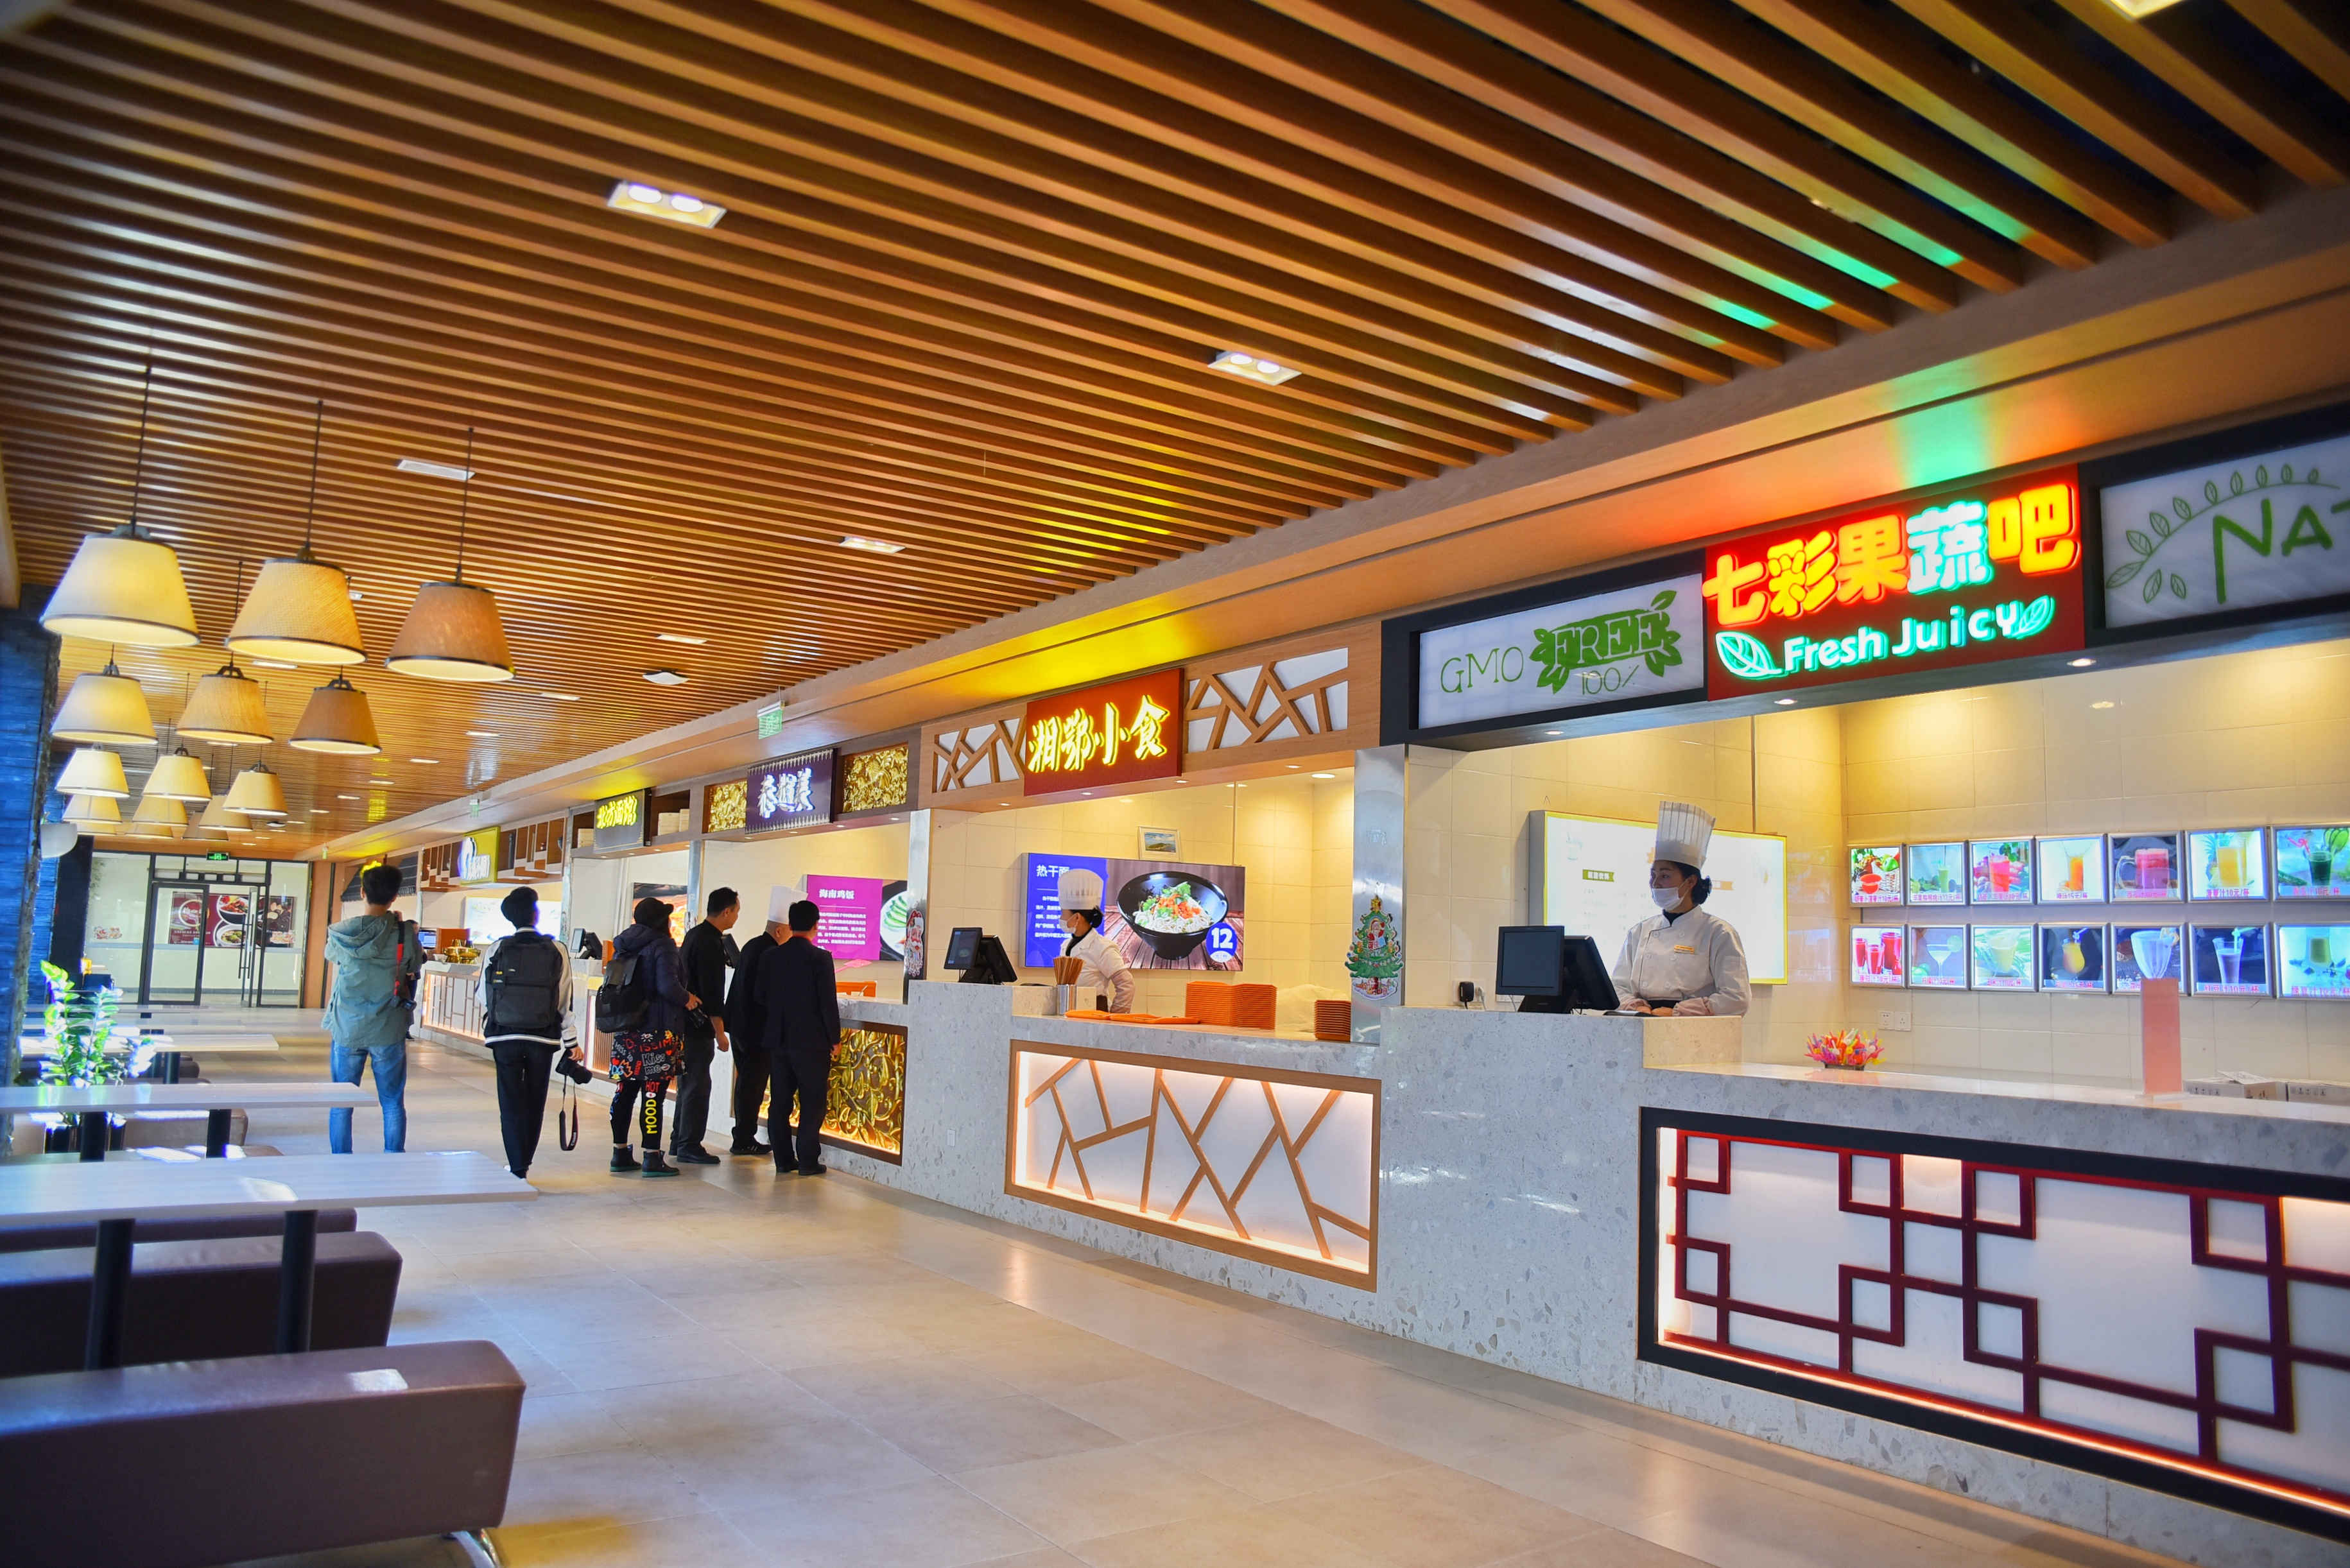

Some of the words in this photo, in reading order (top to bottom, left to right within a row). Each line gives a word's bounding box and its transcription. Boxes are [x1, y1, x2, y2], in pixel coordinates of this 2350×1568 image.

[1703, 484, 2078, 626] 七彩果蔬吧
[2213, 498, 2350, 604] NA
[1440, 646, 1524, 693] GMO
[1552, 610, 1667, 666] FREE
[1784, 626, 1888, 673] Fresh
[1028, 694, 1170, 773] 湘鄂小食
[1211, 927, 1233, 949] 12
[645, 1099, 658, 1134] MOOD
[646, 1081, 661, 1092] HOT
